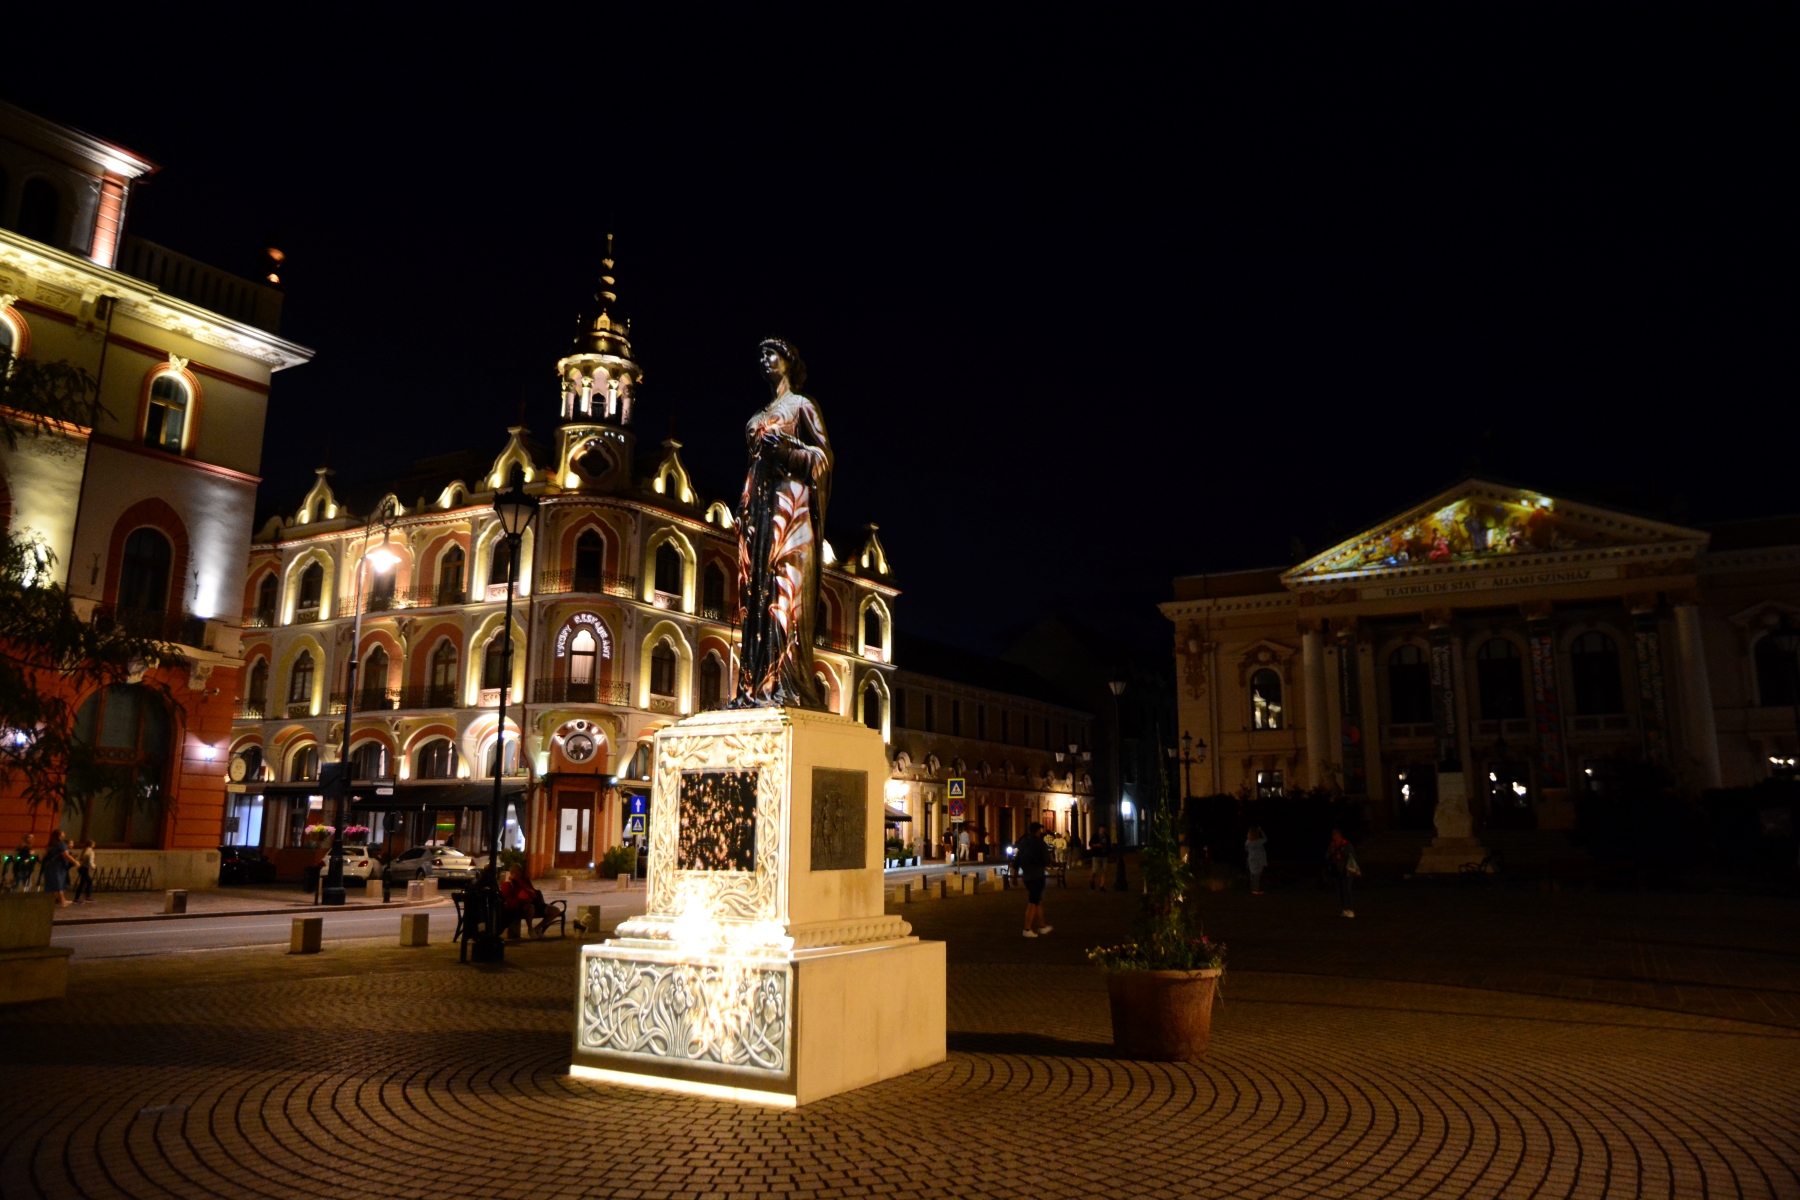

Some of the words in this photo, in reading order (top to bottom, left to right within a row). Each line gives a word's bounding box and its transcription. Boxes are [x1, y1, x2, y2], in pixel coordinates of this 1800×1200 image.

[1385, 586, 1429, 596] TEATRUL
[1433, 584, 1447, 592] DE
[1451, 581, 1477, 590] STAT
[556, 624, 572, 657] LUXURY
[573, 613, 611, 659] RESTAURANT
[1635, 632, 1647, 662] Piano
[1432, 646, 1442, 685] Evening
[1441, 644, 1451, 689] Viennese
[1639, 664, 1652, 699] Recital
[1443, 691, 1455, 734] Operetta
